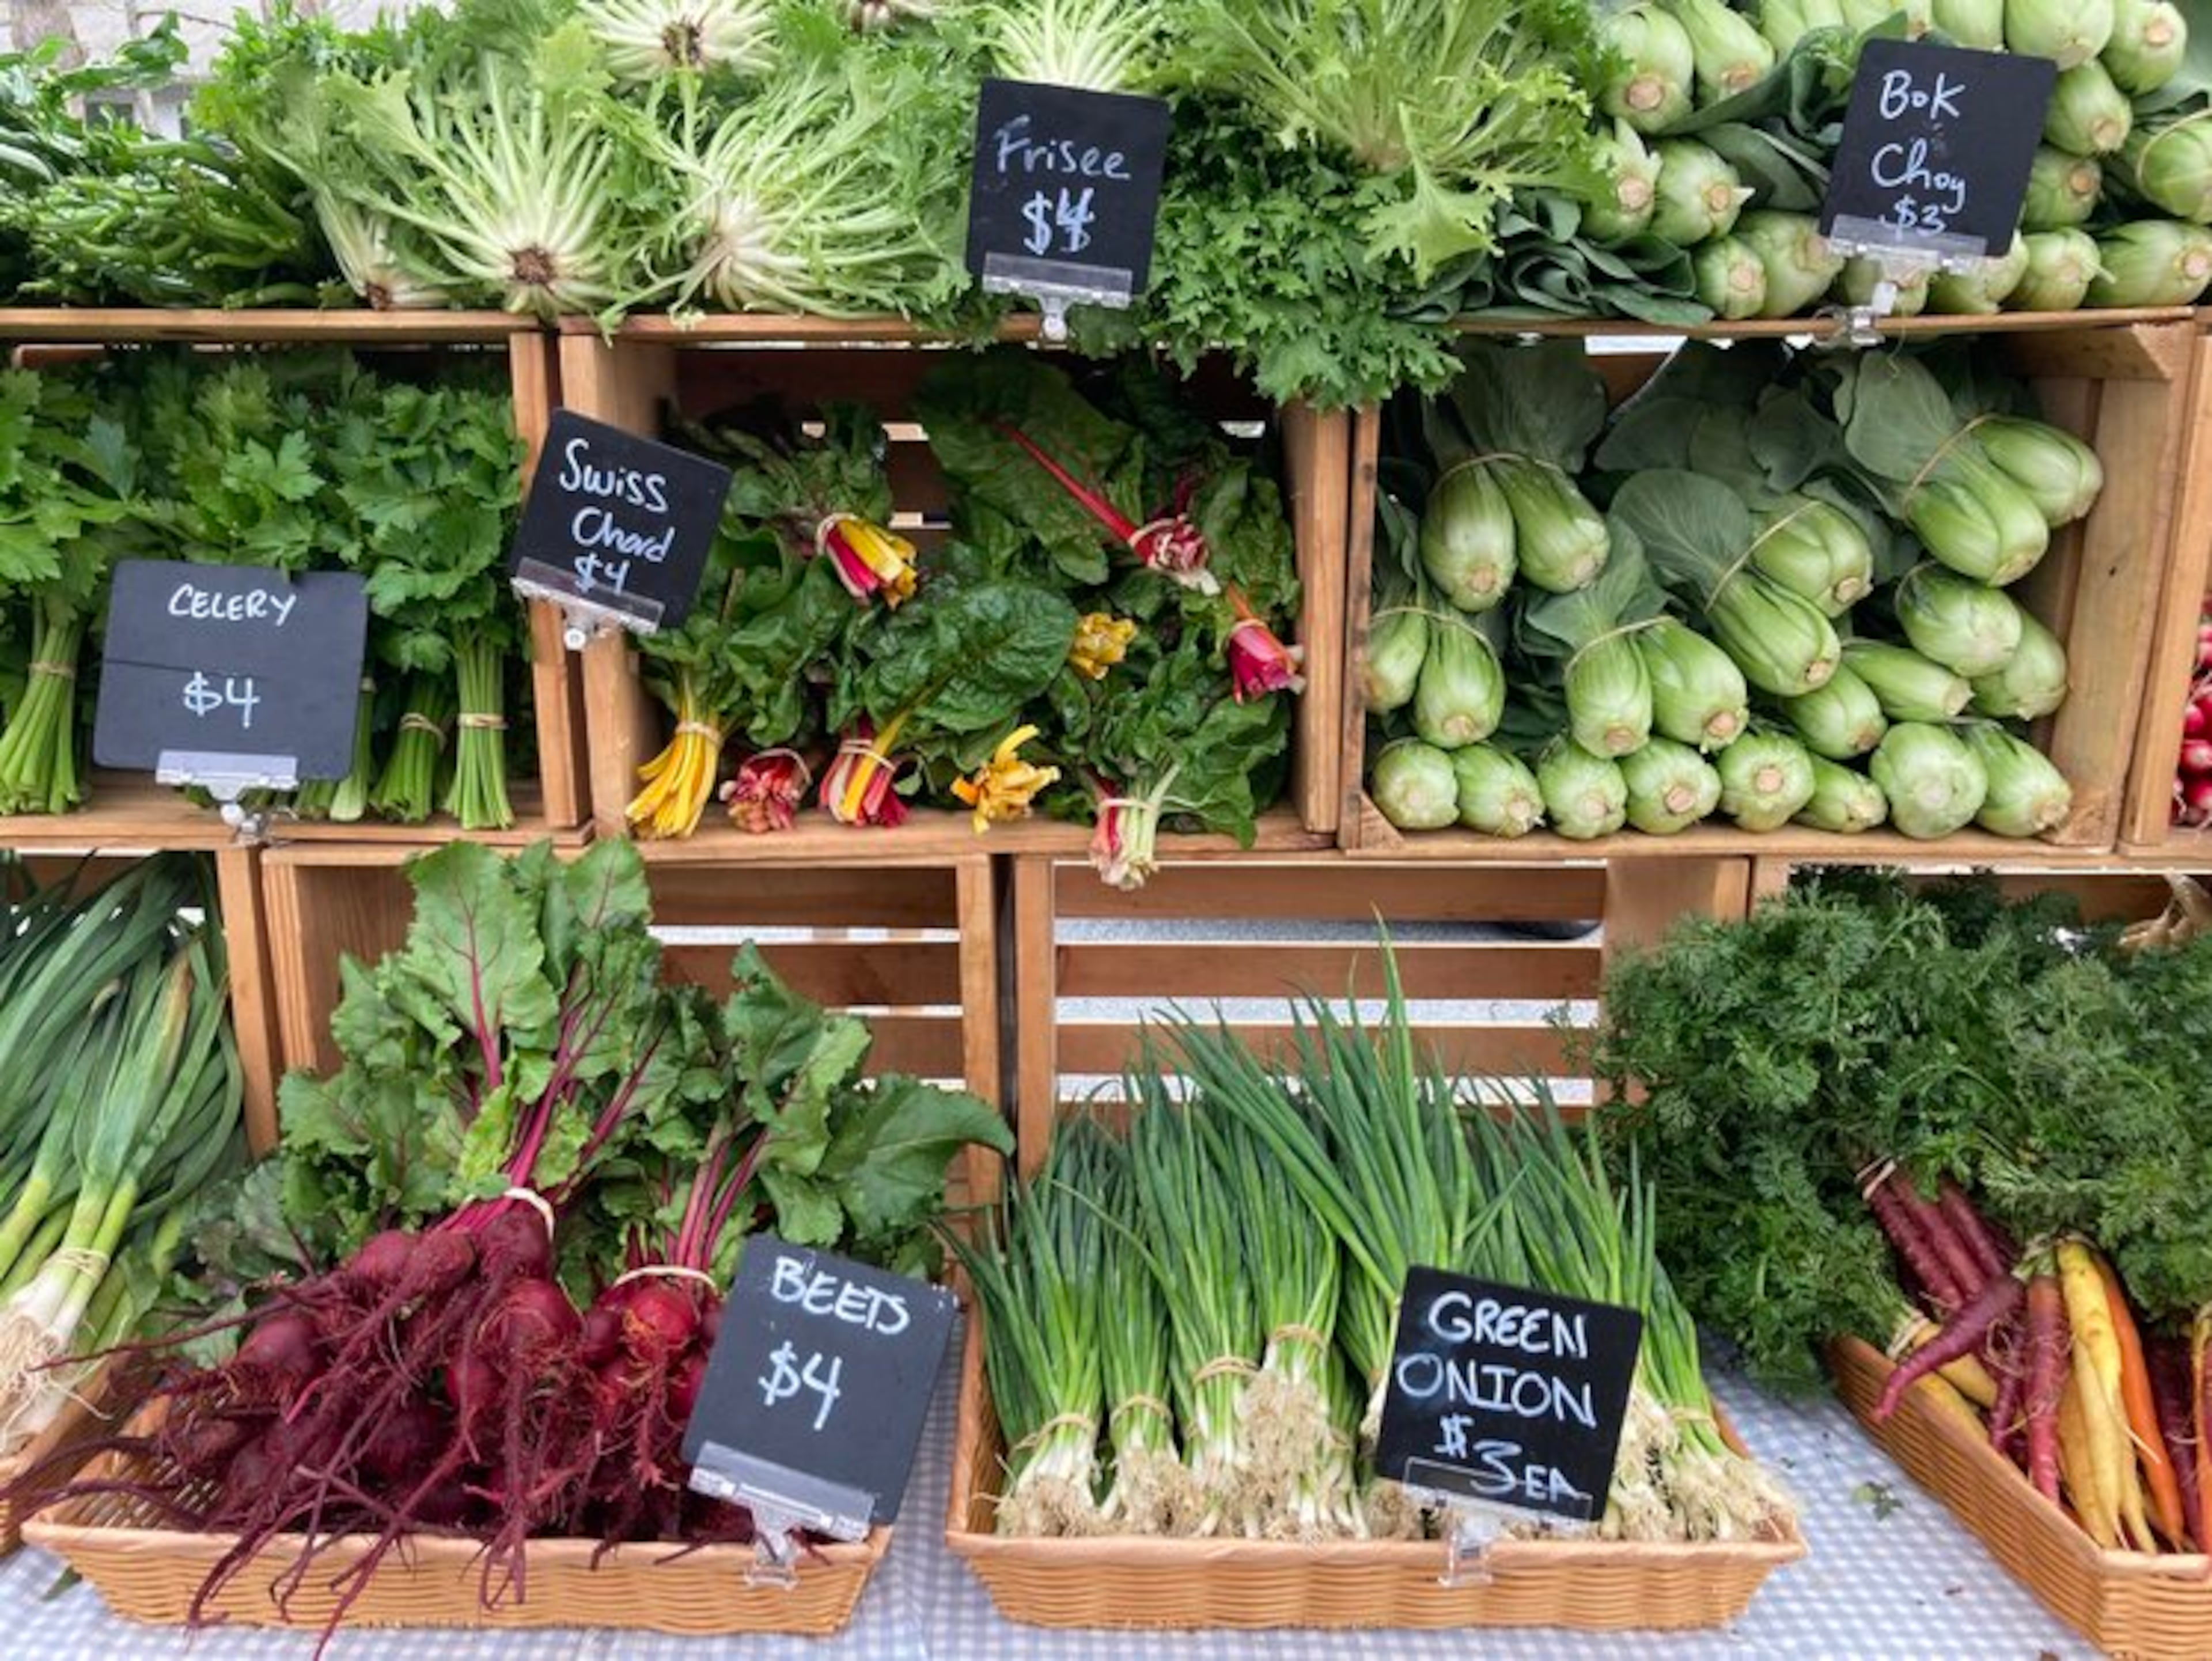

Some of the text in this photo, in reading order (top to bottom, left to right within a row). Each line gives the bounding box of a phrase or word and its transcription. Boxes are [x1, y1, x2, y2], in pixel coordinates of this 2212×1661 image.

[994, 115, 1131, 180] Frisee
[1870, 137, 1965, 213] Choy
[1021, 187, 1094, 255] $4
[1880, 195, 1946, 241] $3
[559, 438, 669, 513] Swiss
[571, 506, 675, 562] Chard
[168, 583, 297, 626] CELERY
[574, 552, 630, 596] $4
[183, 671, 260, 729] $4
[770, 1255, 911, 1335] BEETS
[1428, 1291, 1588, 1359] GREEN
[758, 1341, 843, 1431] $4
[1397, 1353, 1597, 1430] ONION
[1525, 1464, 1580, 1503] EA
